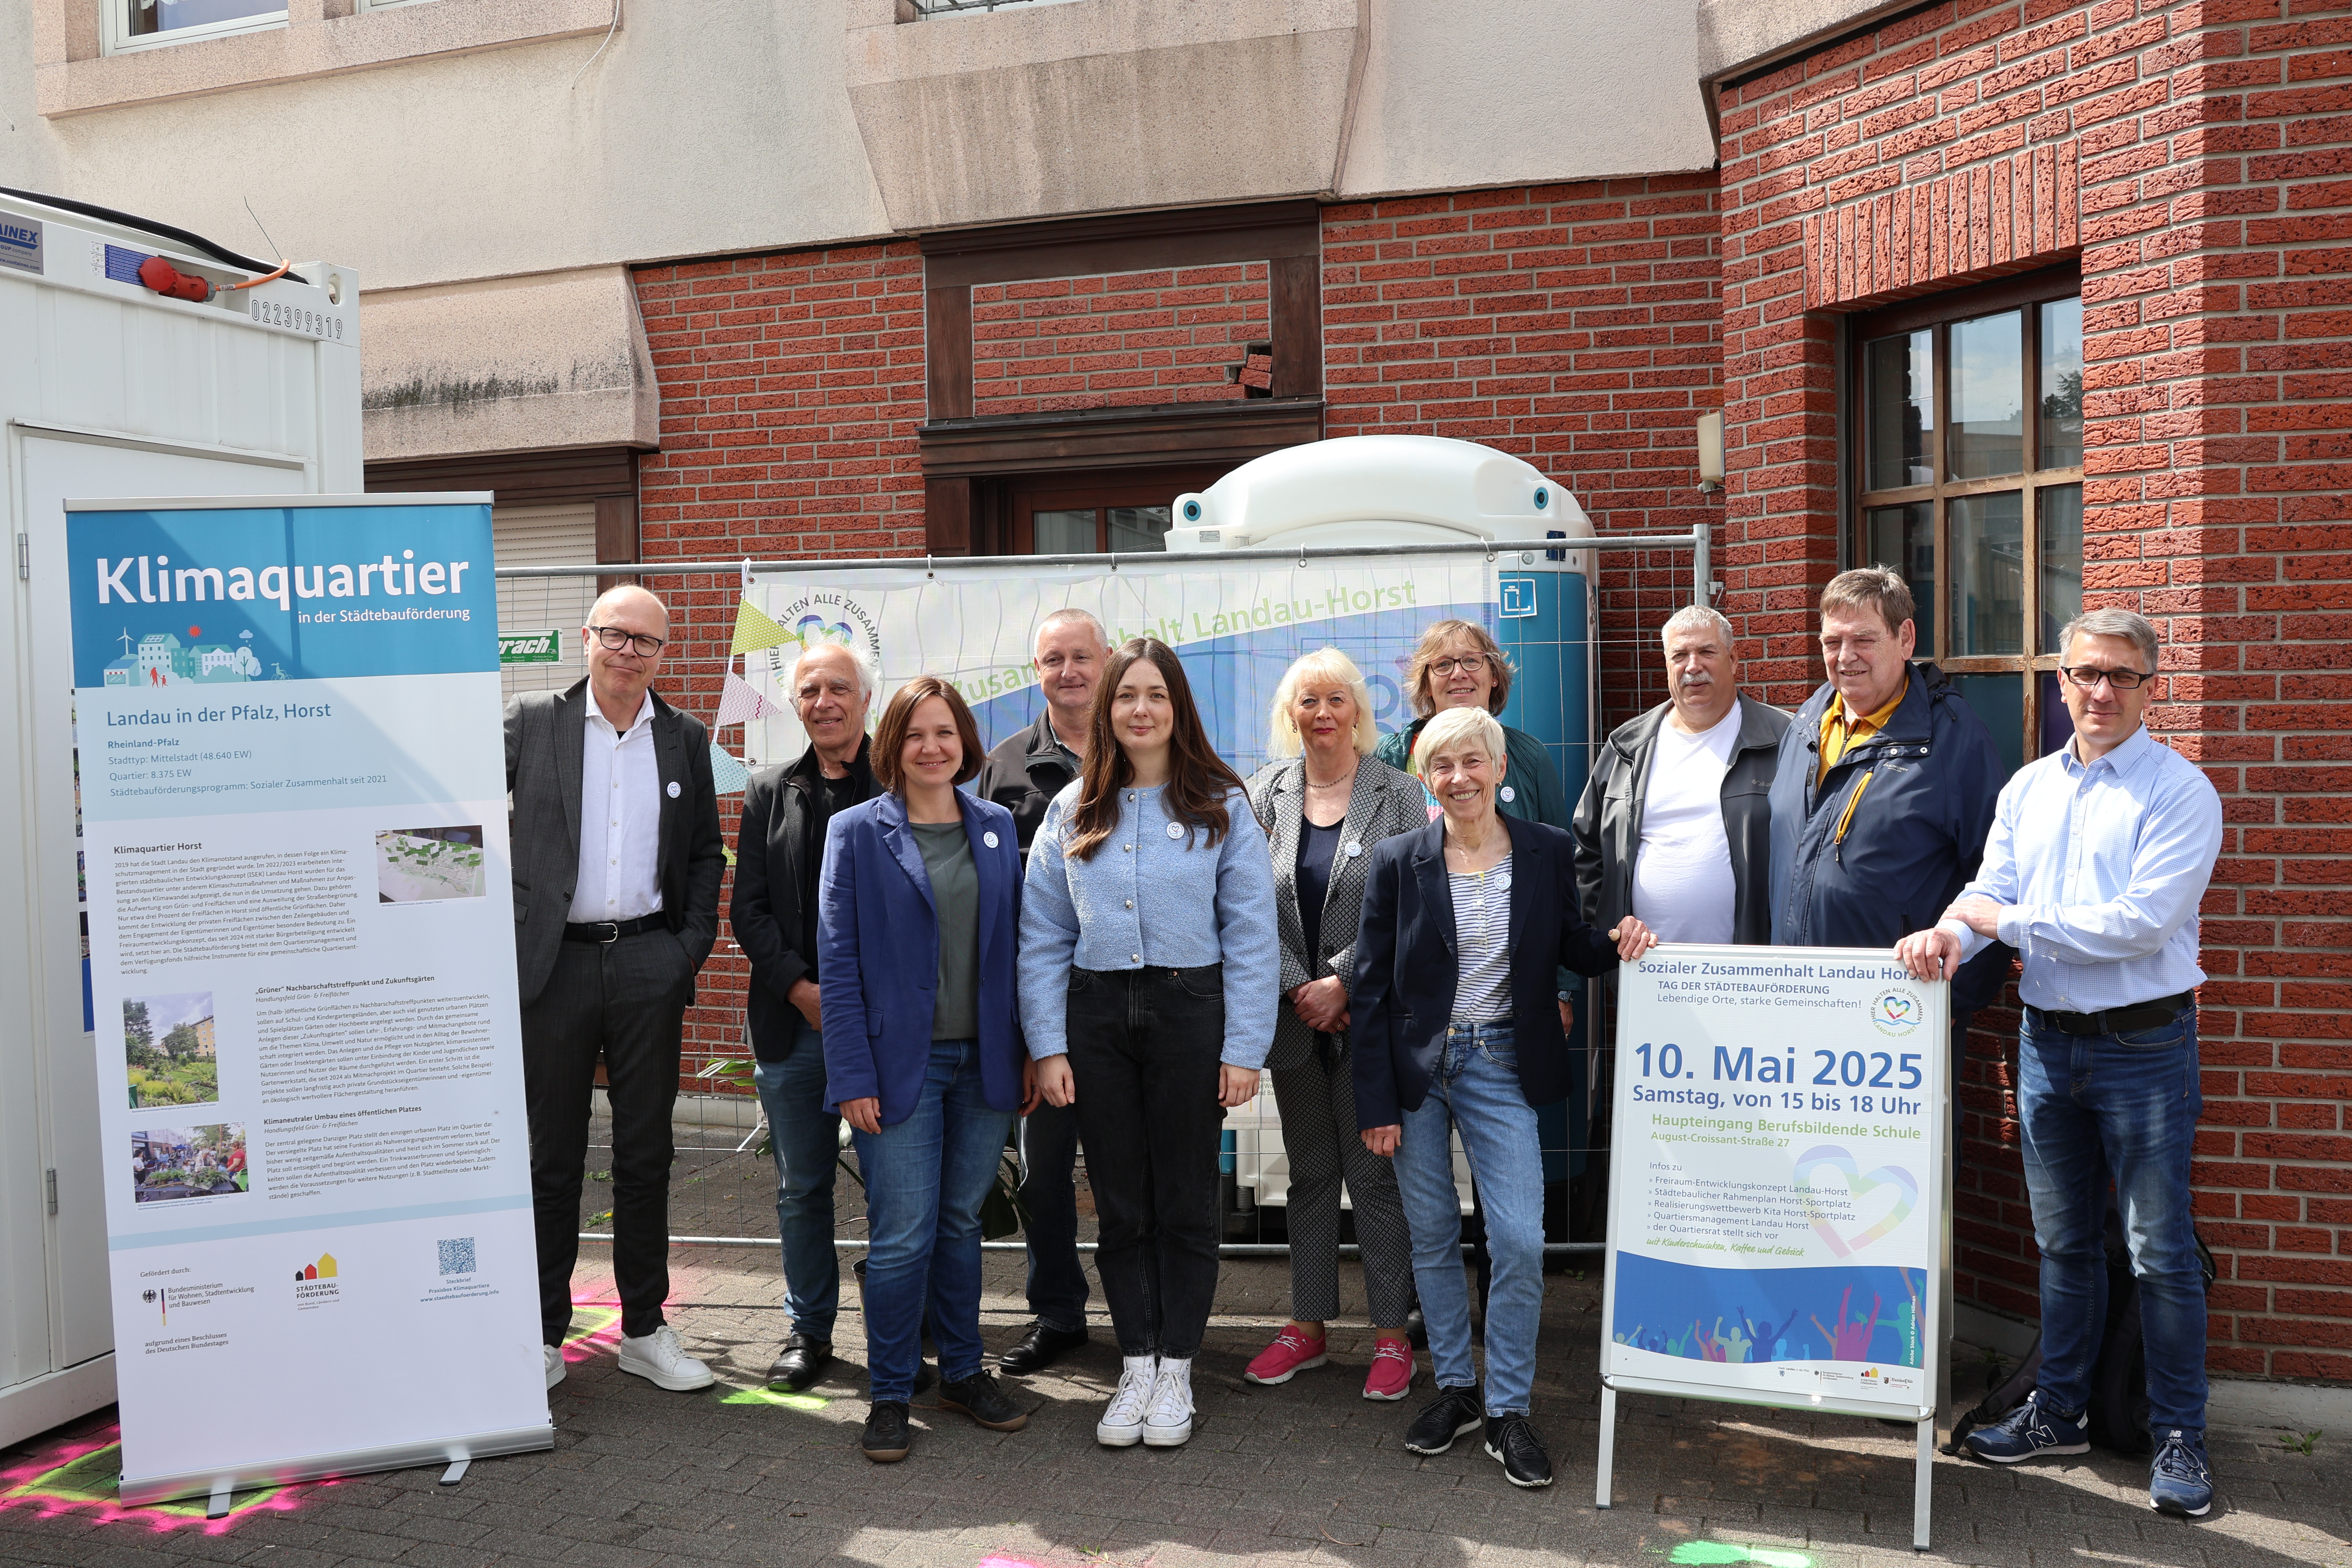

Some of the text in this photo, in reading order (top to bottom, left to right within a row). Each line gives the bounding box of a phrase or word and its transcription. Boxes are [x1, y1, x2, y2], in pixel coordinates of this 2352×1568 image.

[12, 248, 32, 256] company
[252, 299, 343, 339] 022399319
[98, 550, 469, 610] Klimaquartier
[298, 608, 470, 623] in der Städtebauförderung
[777, 597, 809, 627] ALTEN
[814, 593, 842, 606] ALLE
[1192, 580, 1417, 637] Landau-Horst
[107, 704, 331, 726] Landau in der Pfalz, Horst
[108, 739, 179, 748] Rheinland-Pfalz
[109, 750, 251, 765] Stadttyp: Mittelstadt (48.640 EW)
[110, 772, 148, 782] Quartier:
[111, 784, 248, 796] Städtebauförderungsprogramm:
[251, 780, 283, 789] Sozialer
[286, 777, 348, 787] Zusammenhalt
[114, 844, 175, 854] Klimaquartier
[1639, 961, 1697, 974] Sozialer
[1702, 963, 1813, 977] Zusammenhalt
[1819, 966, 1875, 979] Landau
[256, 986, 284, 995] „Grüner“
[286, 980, 370, 991] Nachbarschaftstreffpunkt
[1658, 981, 1677, 989] TAG
[1704, 981, 1829, 994] STÄDTEBAUFÖRDERUNG
[1658, 994, 1861, 1008] Lebendige Orte, starke Gemeinschaften!
[1872, 989, 1891, 1005] HALTEN
[1906, 991, 1923, 1021] ZUSAMMEN
[1873, 1022, 1917, 1037] LANDAU HORST
[1635, 1043, 1922, 1089] 10. Mai 2025
[1633, 1085, 1921, 1114] Samstag, von 15 bis 18 Uhr
[264, 1116, 313, 1125] Klimaneutraler
[1653, 1114, 1920, 1139] Haupteingang Berufsbildende Schule
[265, 1125, 304, 1133] Handlungsfeld
[1651, 1132, 1789, 1147] August-Croissant-Straße 27
[1656, 1176, 1848, 1196] Freiraum-Entwicklungskonzept Landau-Horst
[1655, 1188, 1851, 1209] Städtebaulicher Rahmenplan Horst-Sportplatz
[1655, 1200, 1760, 1214] Realisierungswettbewerb
[1784, 1209, 1855, 1221] Horst-Sportplatz
[1654, 1212, 1809, 1229] Quartiersmanagement Landau Horst
[1670, 1225, 1720, 1235] Quartiersrat
[1662, 1238, 1727, 1252] Kinderschminken,
[1730, 1243, 1756, 1254] Kaffee
[1757, 1245, 1775, 1254] und
[1775, 1246, 1804, 1256] Gebäck
[168, 1283, 223, 1293] Bundesministerium
[205, 1287, 254, 1297] Stadtentwicklung
[296, 1283, 339, 1292] STÄDTEBAU-
[296, 1289, 339, 1299] FÖRDERUNG
[182, 1299, 211, 1307] Bauwesen
[420, 1290, 499, 1302] www.staedtebaufoerderung.info
[191, 1340, 229, 1348] Bundestages
[192, 1333, 227, 1341] Beschlusses
